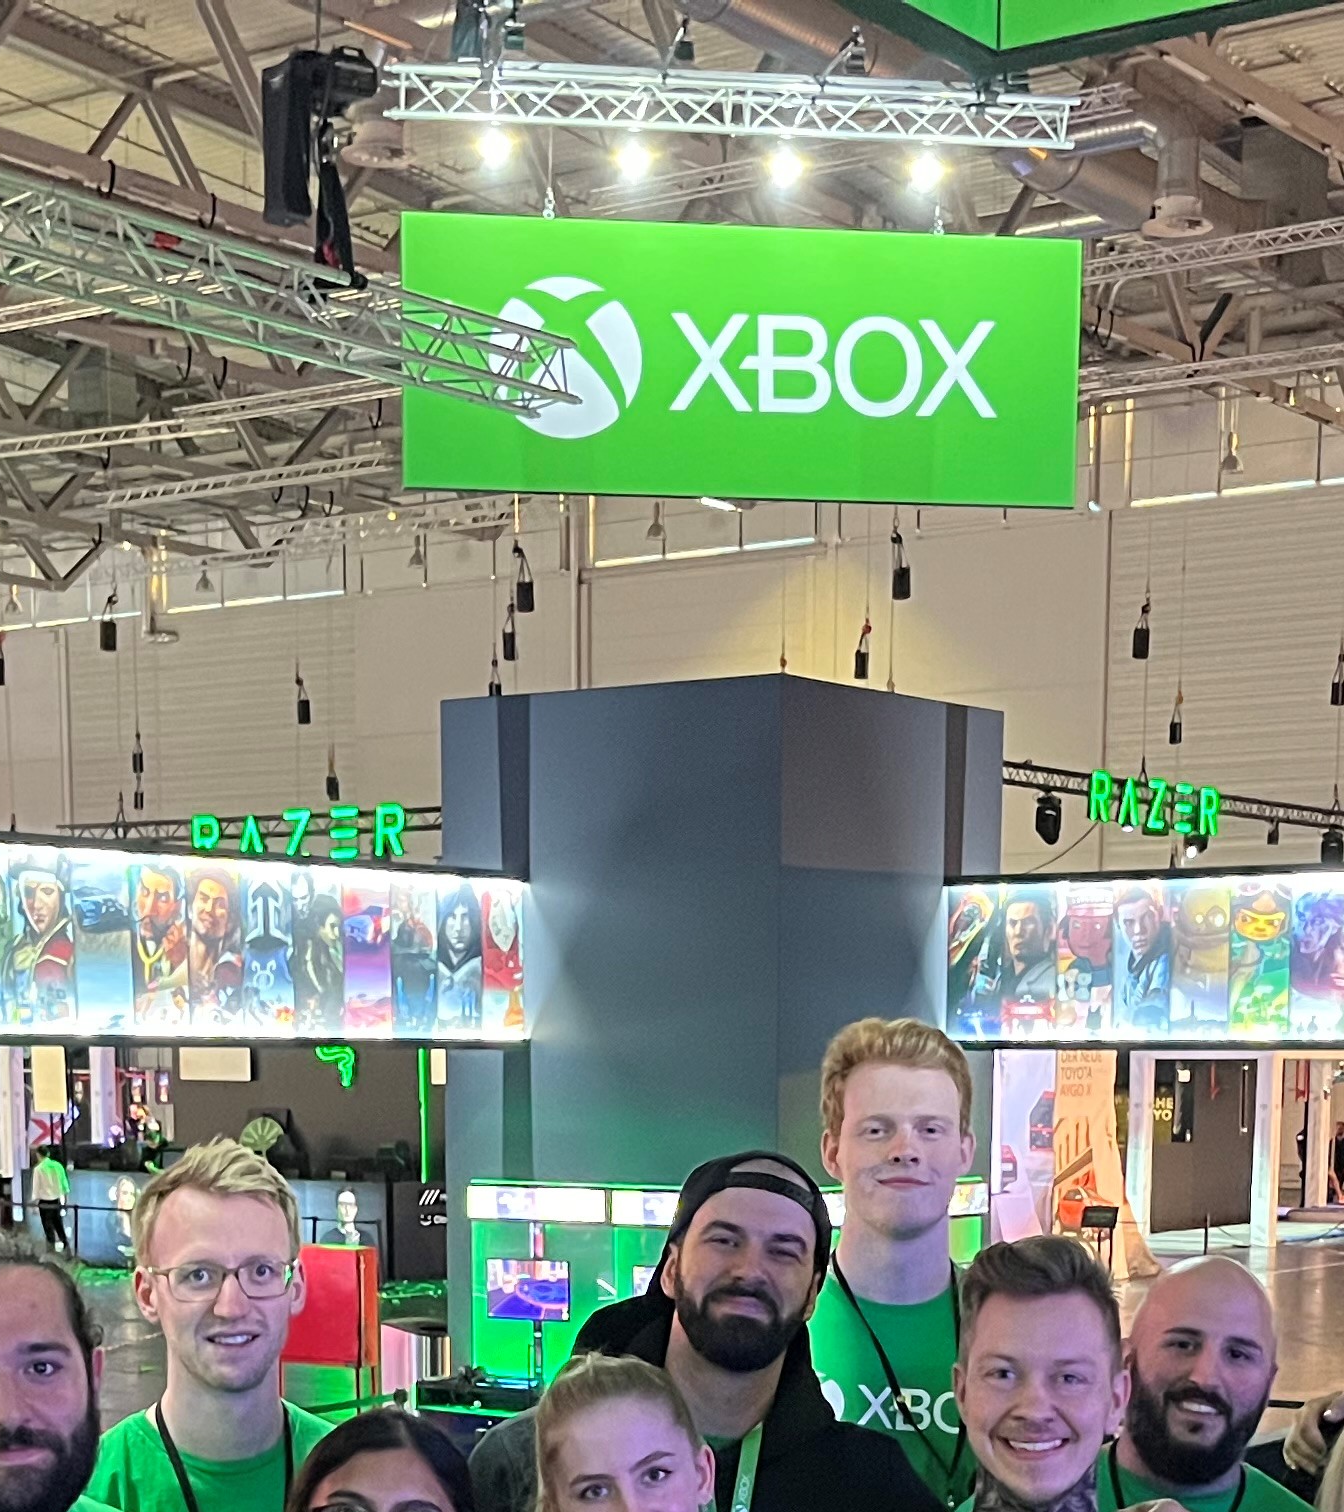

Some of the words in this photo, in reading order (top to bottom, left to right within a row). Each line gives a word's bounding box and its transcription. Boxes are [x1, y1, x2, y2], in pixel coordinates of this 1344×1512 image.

[669, 312, 997, 419] XBOX
[1087, 769, 1220, 836] RAZER
[857, 1384, 960, 1435] XBO
